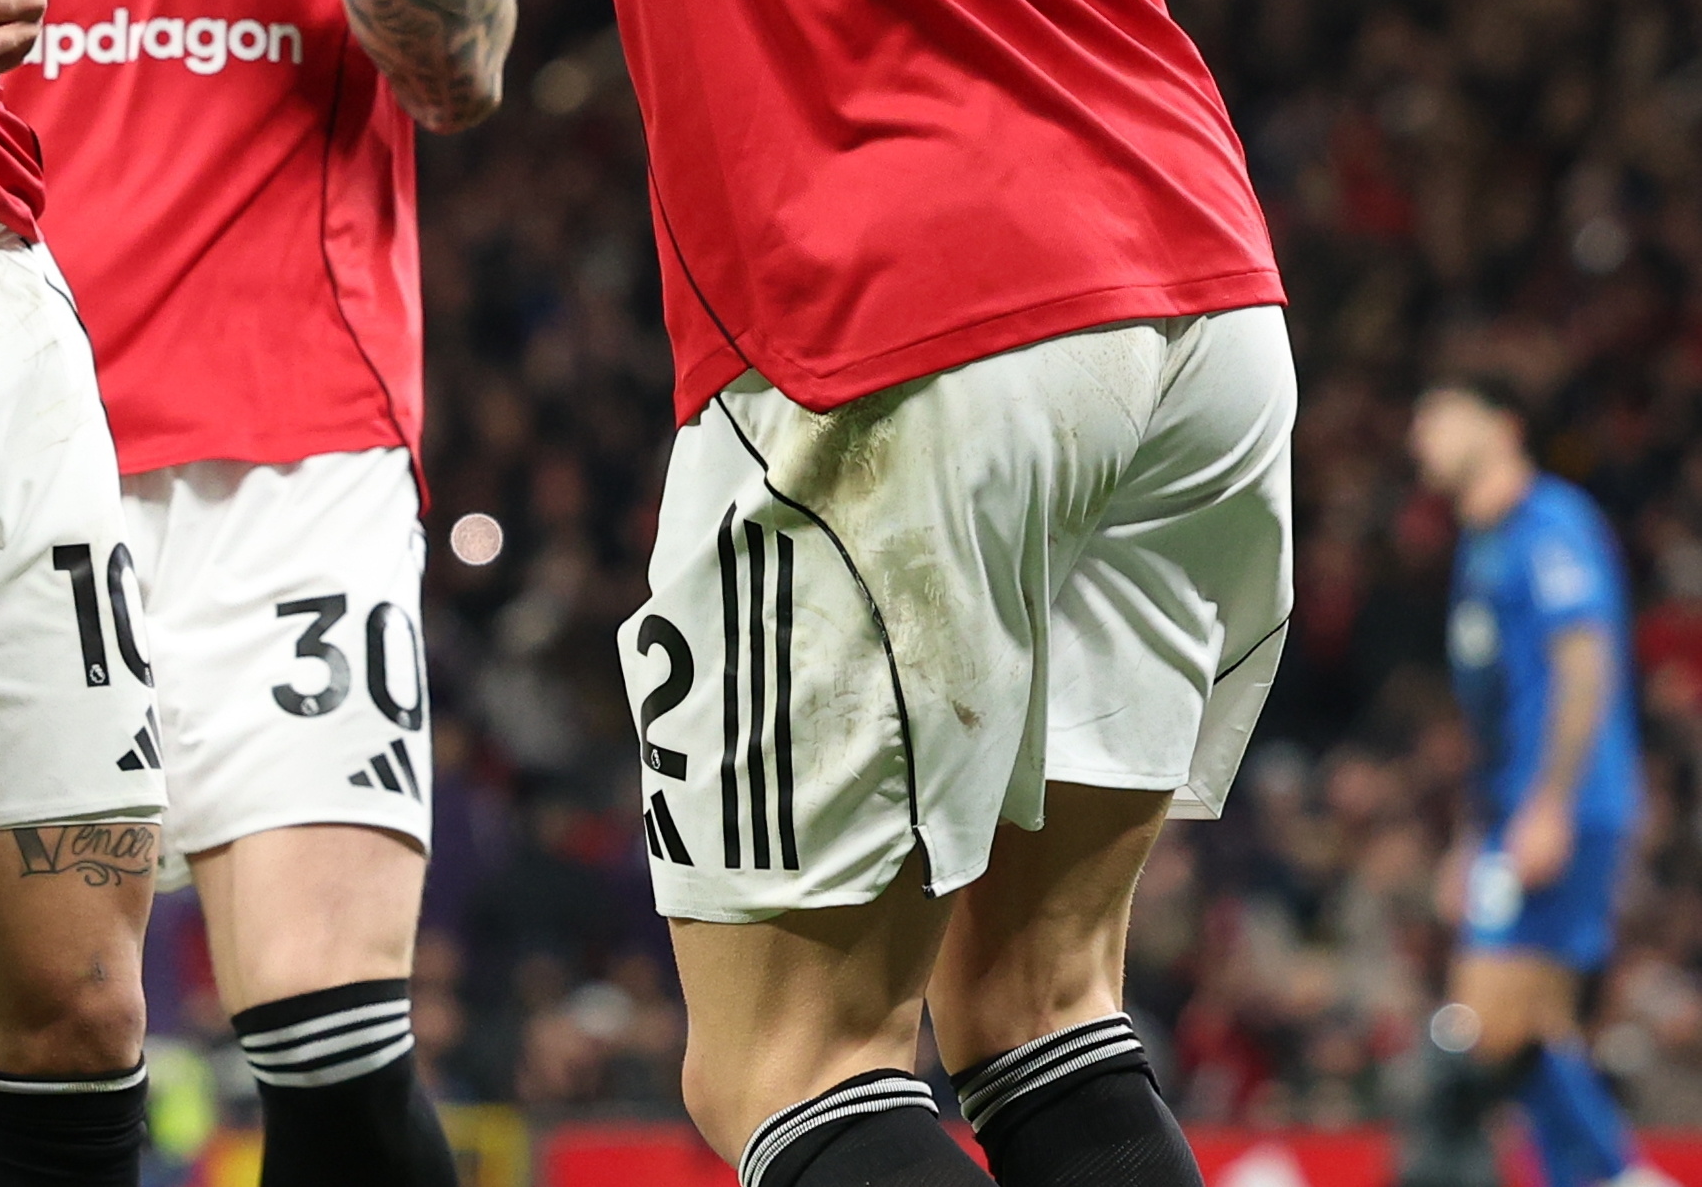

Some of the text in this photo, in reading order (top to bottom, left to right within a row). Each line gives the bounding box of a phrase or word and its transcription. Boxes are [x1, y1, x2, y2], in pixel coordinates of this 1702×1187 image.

[52, 542, 155, 689] 10
[271, 593, 423, 732] 30
[636, 614, 695, 782] 2
